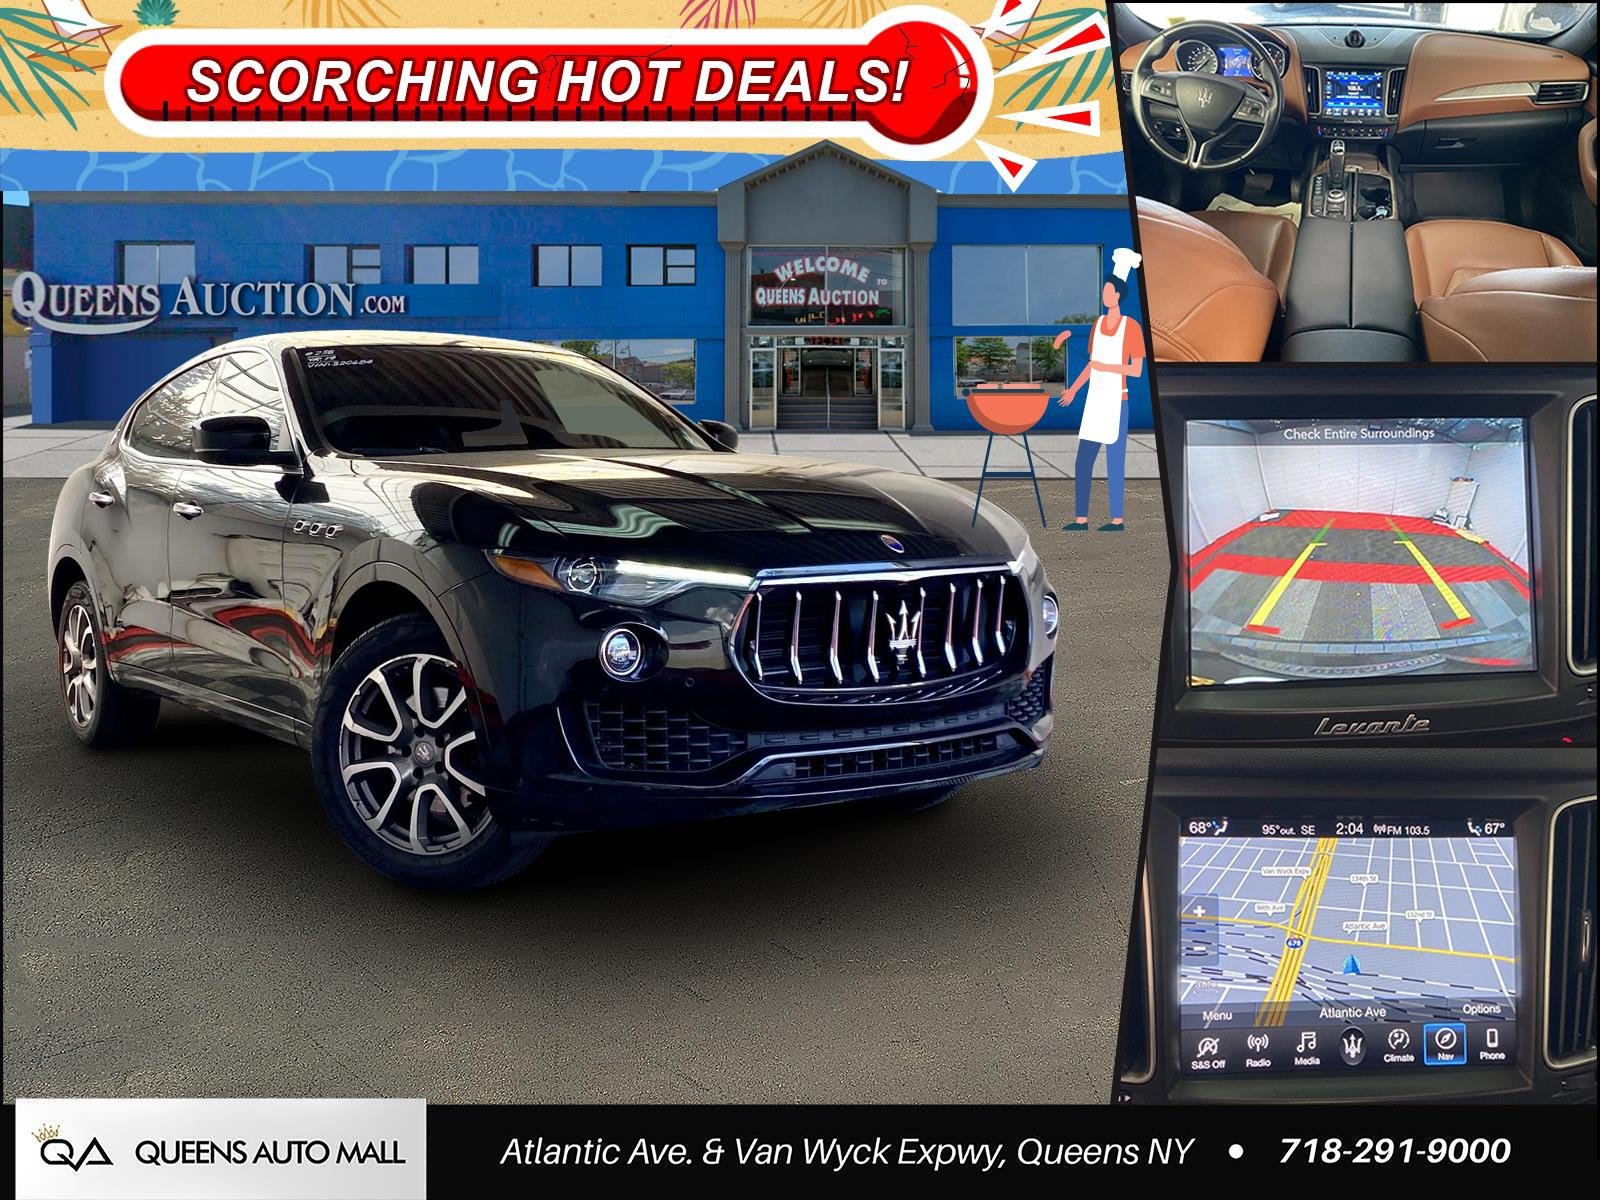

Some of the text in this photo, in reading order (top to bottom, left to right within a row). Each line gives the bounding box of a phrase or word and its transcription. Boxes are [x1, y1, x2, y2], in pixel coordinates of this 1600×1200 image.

[774, 256, 888, 286] WELCOME TO
[755, 287, 880, 305] QUEENS AUCTION
[11, 271, 405, 335] QUEENS AUCTION .COM
[1283, 428, 1435, 440] Check Entire Surroundings
[1313, 713, 1431, 736] Levante
[1188, 821, 1212, 834] 68°
[1300, 825, 1316, 835] SE
[1336, 823, 1364, 835] 2:04
[1387, 826, 1430, 836] FM 103.5
[1484, 822, 1506, 834] 67°
[1344, 922, 1386, 930] Atlantic Ave
[1319, 1006, 1387, 1019] Atlantic Ave
[1463, 1003, 1502, 1016] Options
[1203, 1011, 1233, 1021] Menu
[1294, 1056, 1321, 1066] Media
[1383, 1053, 1415, 1063] Climate
[1438, 1053, 1454, 1061] Nav
[1480, 1051, 1506, 1060] Phone
[1191, 1059, 1227, 1070] S&S Off
[1246, 1058, 1272, 1068] Radio
